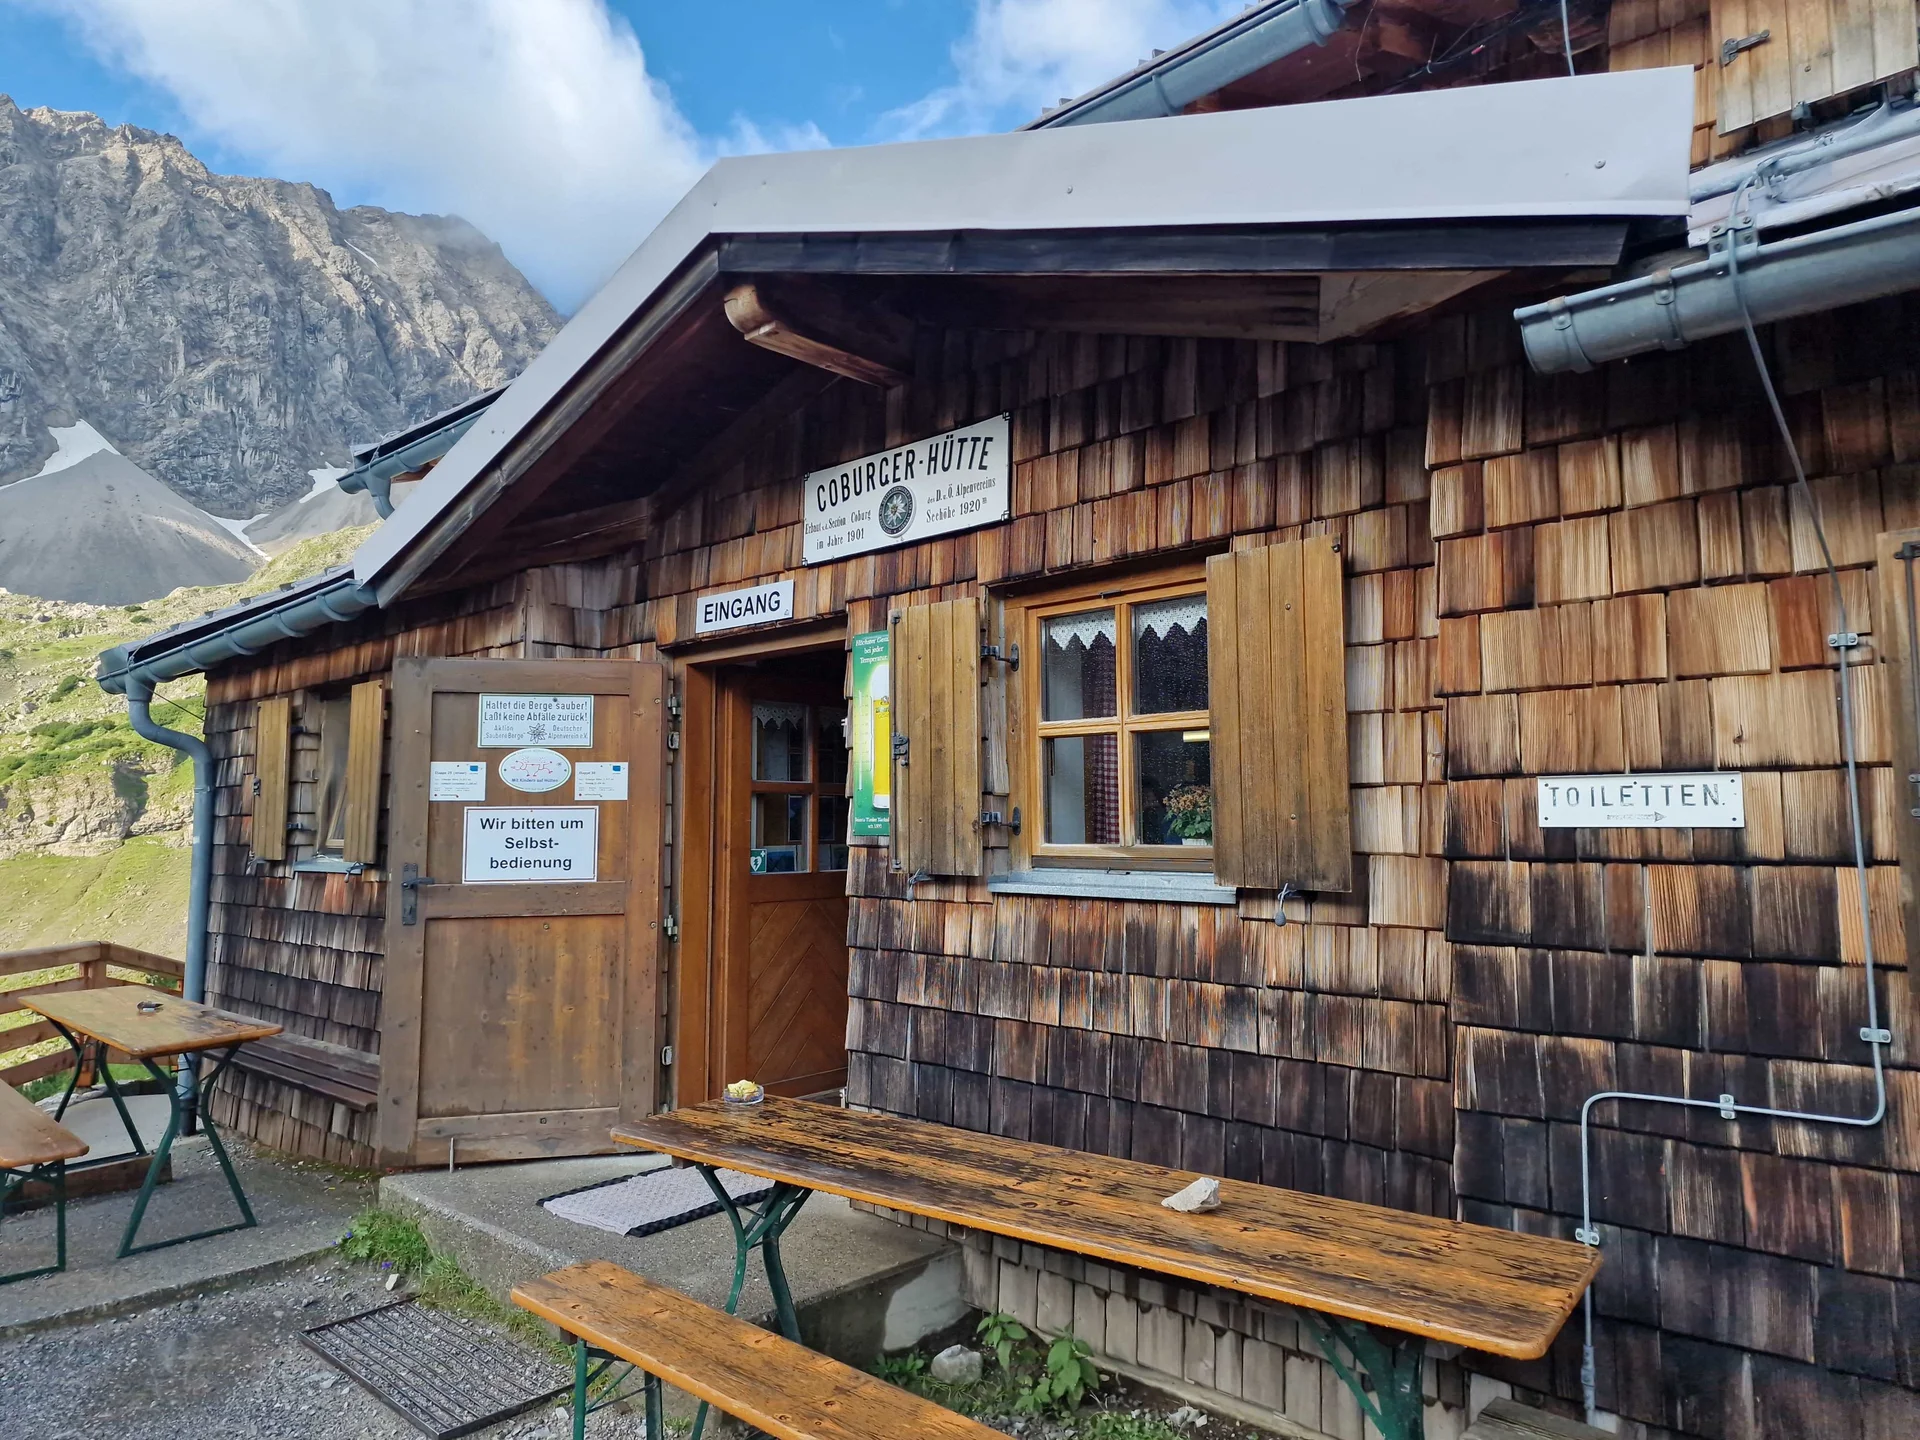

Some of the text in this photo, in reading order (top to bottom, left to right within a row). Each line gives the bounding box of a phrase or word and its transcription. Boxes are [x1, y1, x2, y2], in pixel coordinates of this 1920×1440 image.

[956, 476, 996, 498] Alpenvereins
[850, 510, 871, 523] Coburg
[926, 506, 956, 523] Seehöhe
[960, 498, 980, 516] 1920
[827, 534, 844, 548] Jahre
[848, 528, 864, 542] 1901
[704, 591, 780, 624] EINGANG
[486, 700, 588, 712] Haltet die Berge sauber!
[484, 712, 588, 722] Laßt keine Abfälle zurück!
[480, 818, 584, 830] Wir bitten um
[504, 836, 560, 849] Selbst-
[490, 856, 572, 870] bedienung
